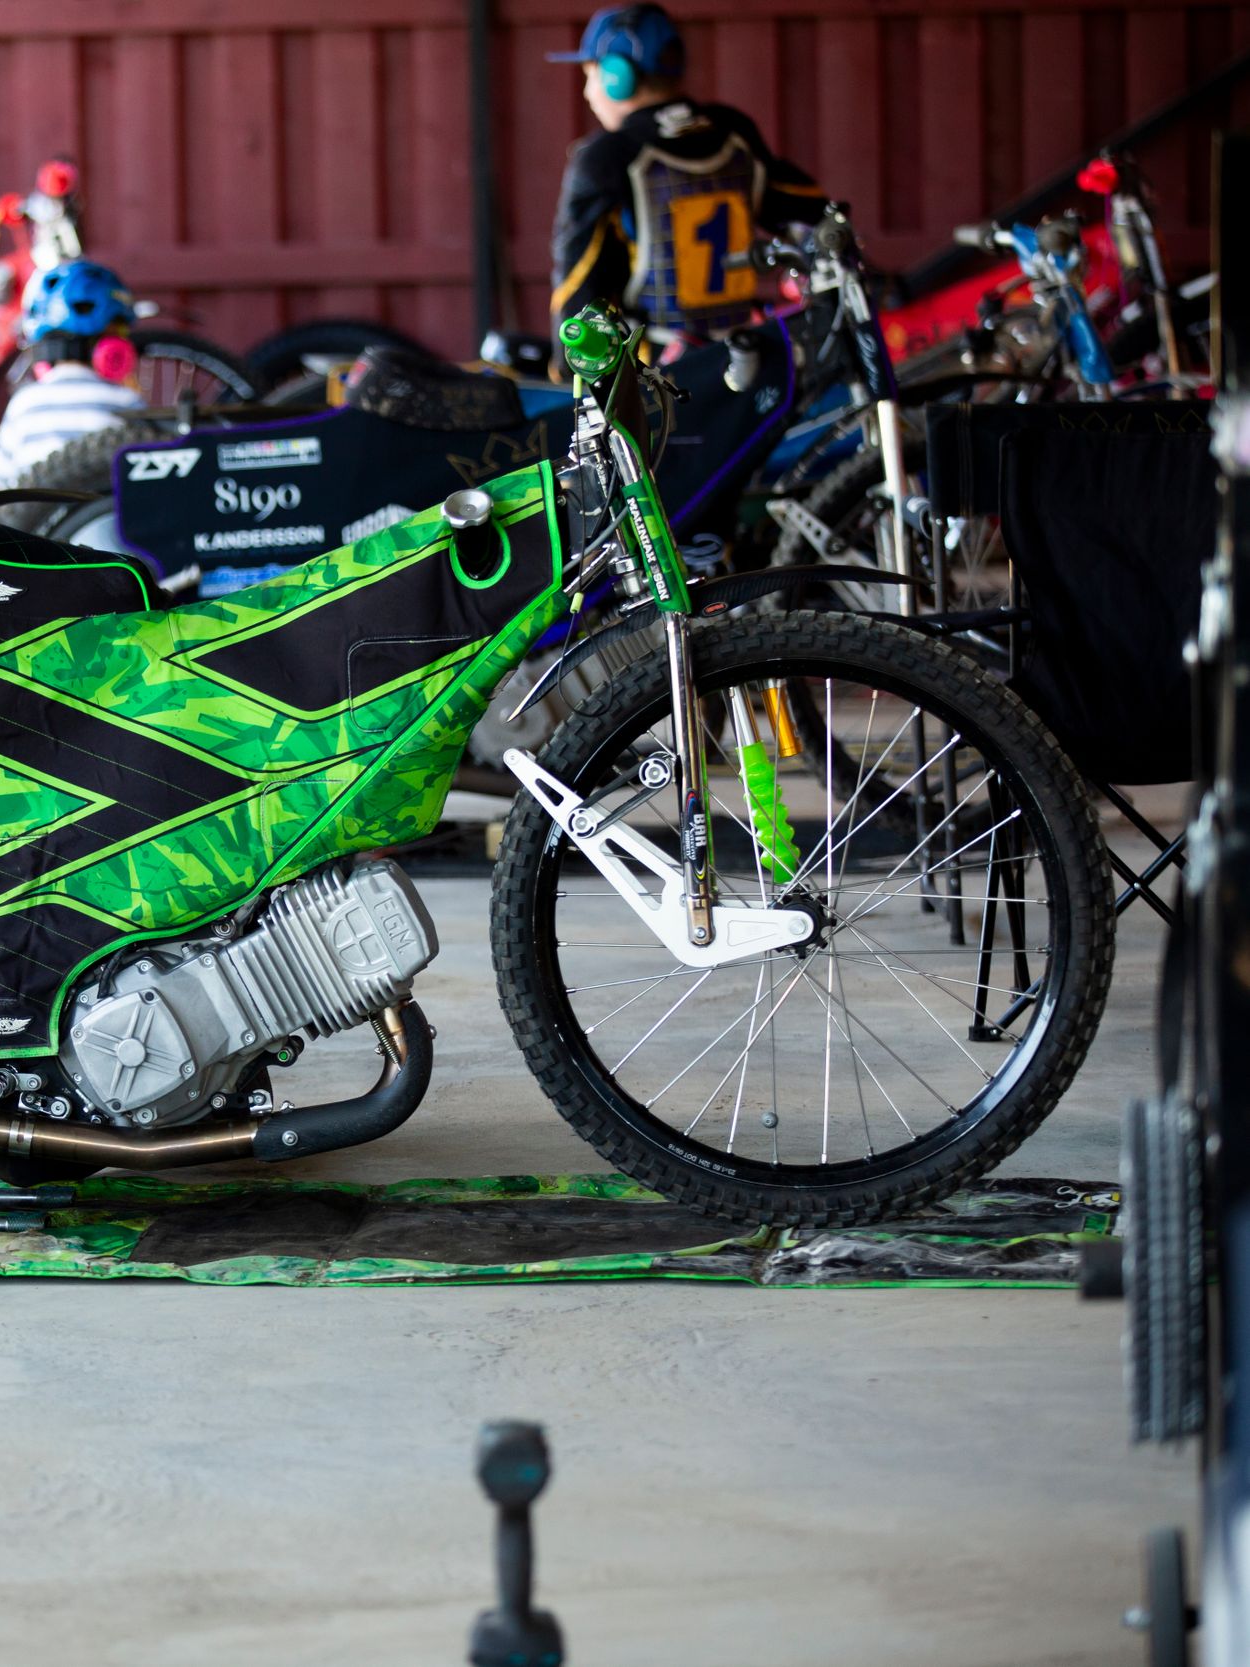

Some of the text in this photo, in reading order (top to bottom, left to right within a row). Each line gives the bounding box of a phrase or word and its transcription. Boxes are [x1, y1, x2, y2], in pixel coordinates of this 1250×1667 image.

[694, 201, 729, 293] 1
[193, 524, 325, 552] K.ANDERSSON
[626, 496, 656, 563] MALINIAK
[693, 813, 707, 847] BAR
[683, 1152, 698, 1162] DOT
